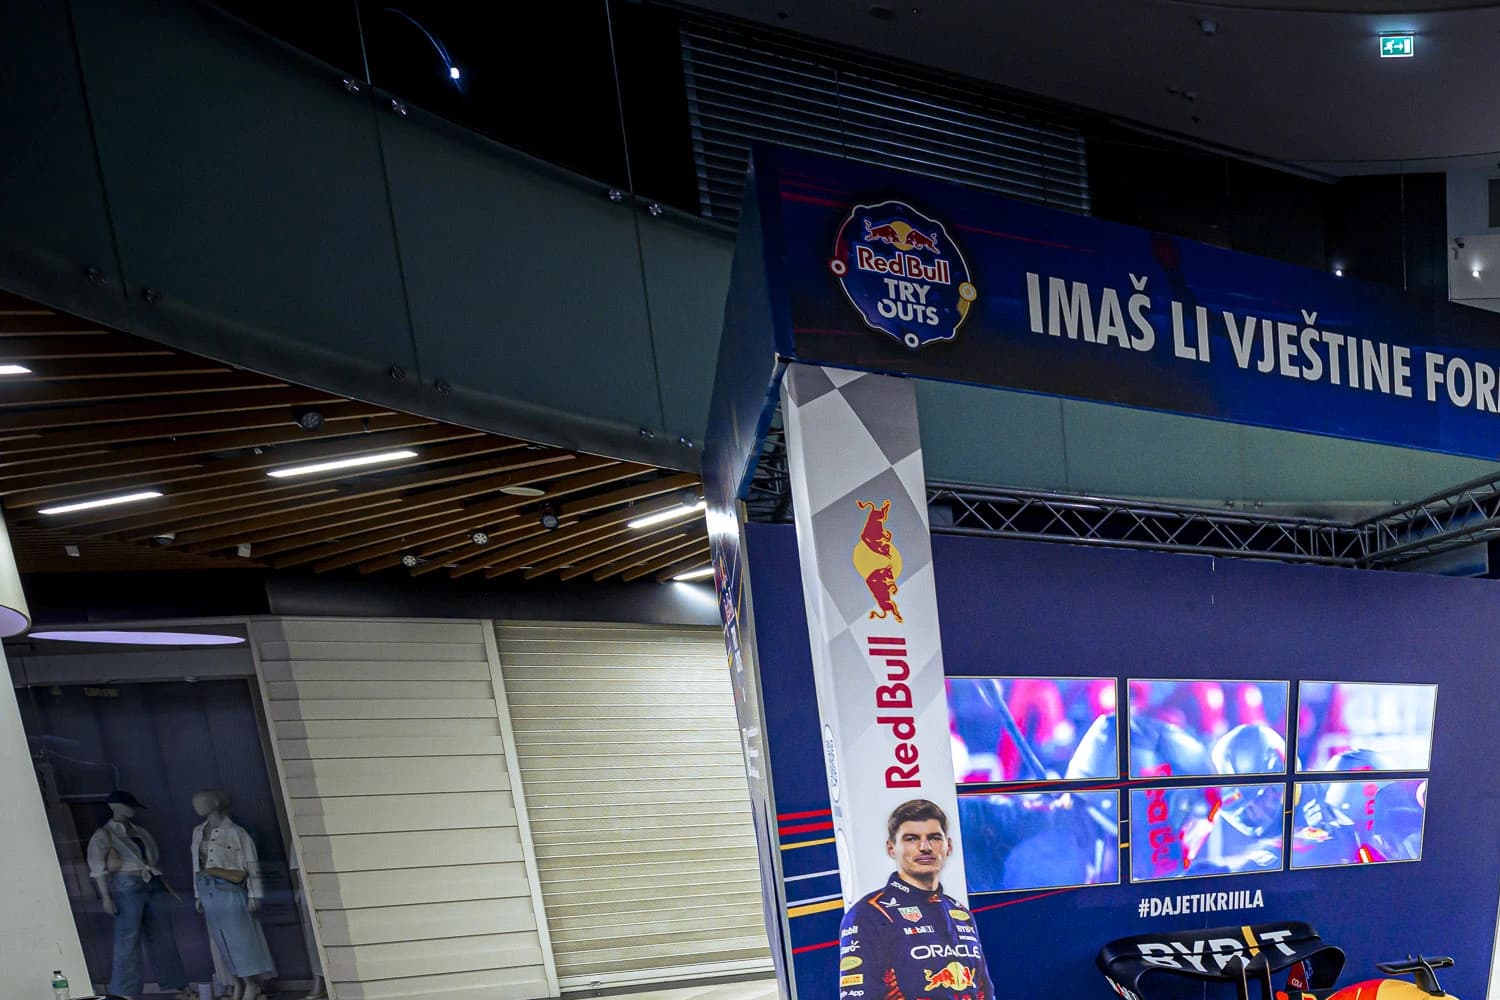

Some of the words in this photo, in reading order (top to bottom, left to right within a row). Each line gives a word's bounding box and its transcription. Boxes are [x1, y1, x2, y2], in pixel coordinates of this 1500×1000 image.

[856, 246, 904, 277] Red
[905, 255, 951, 285] Bull
[884, 278, 931, 305] TRY
[877, 299, 939, 326] OUTS
[1026, 272, 1156, 353] IMAŠ
[1171, 300, 1211, 363] LI
[1222, 309, 1413, 398] VJEŠTINE
[867, 636, 913, 711] Bull
[876, 716, 922, 789] Red
[1138, 889, 1265, 919] #DAJETIKRIIILA
[910, 944, 981, 960] ORACLE
[1137, 925, 1297, 973] BYBIT
